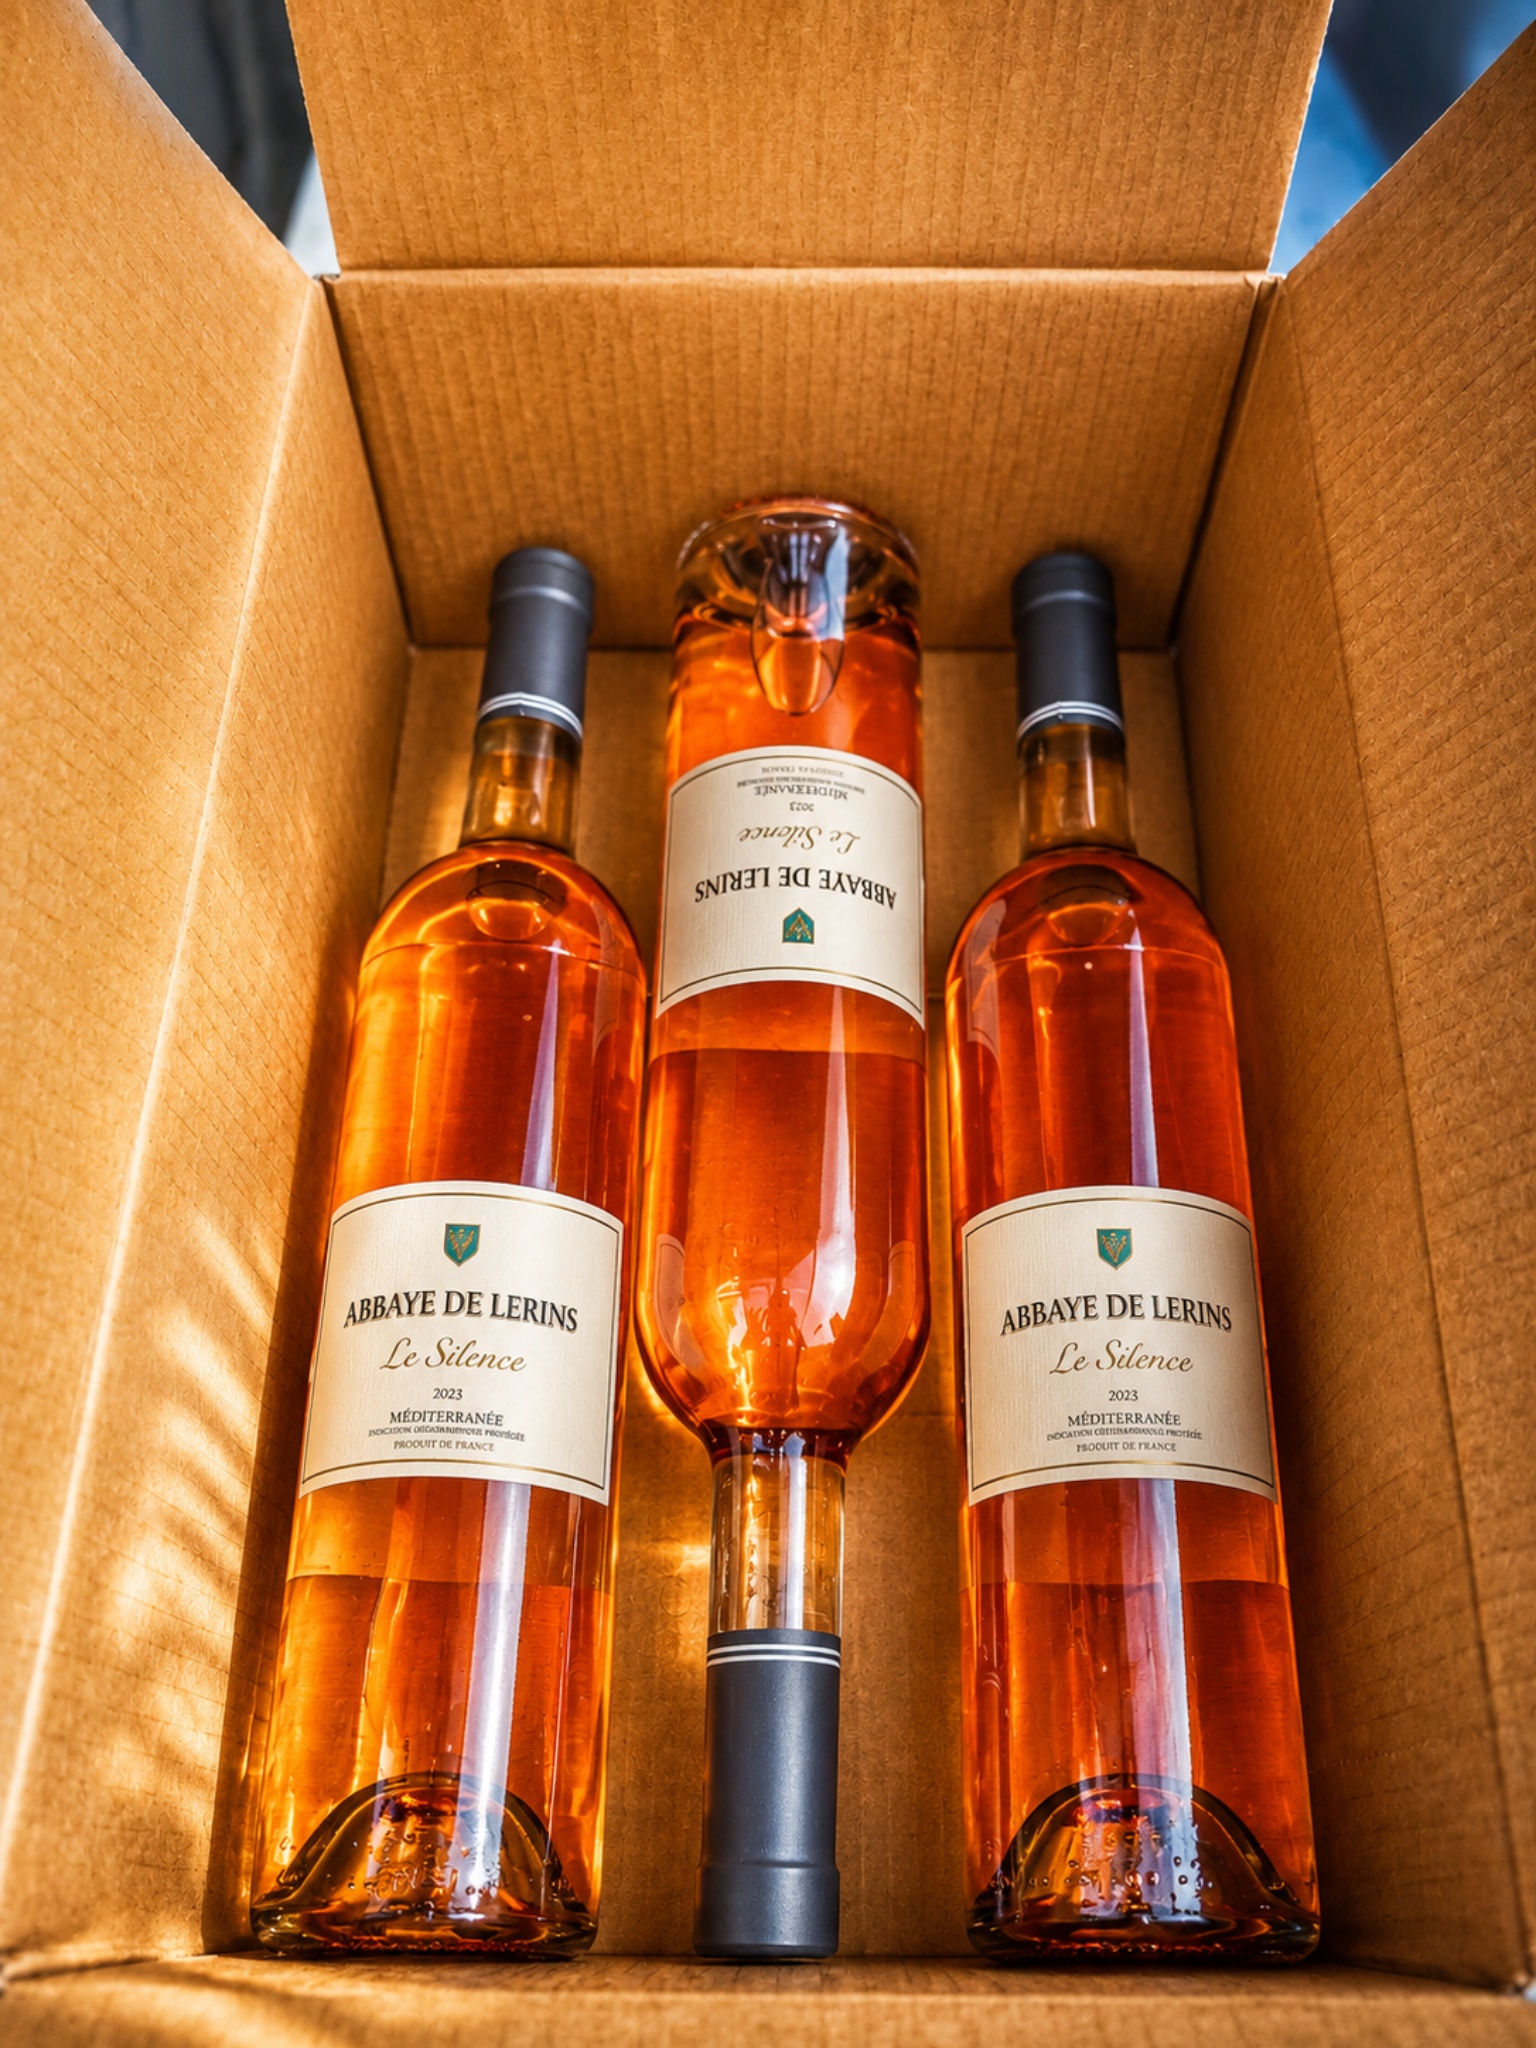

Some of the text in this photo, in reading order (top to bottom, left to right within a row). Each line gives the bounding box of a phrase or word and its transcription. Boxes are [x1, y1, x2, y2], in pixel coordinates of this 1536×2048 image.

[829, 831, 861, 855] Le
[694, 866, 897, 910] ABBAYE DE LERINS
[343, 1290, 579, 1333] ABBAYE DE LERINS
[1000, 1293, 1233, 1336] ABBAYE DE LERINS
[379, 1336, 528, 1372] Le Silence
[1049, 1338, 1194, 1375] Le Silence
[432, 1387, 464, 1401] 2023
[1108, 1389, 1139, 1402] 2023
[389, 1408, 504, 1427] MÉDITERRANÉE
[1067, 1410, 1182, 1427] MÉDITERRANÉE
[439, 1440, 452, 1449] DE
[1122, 1442, 1136, 1451] DE
